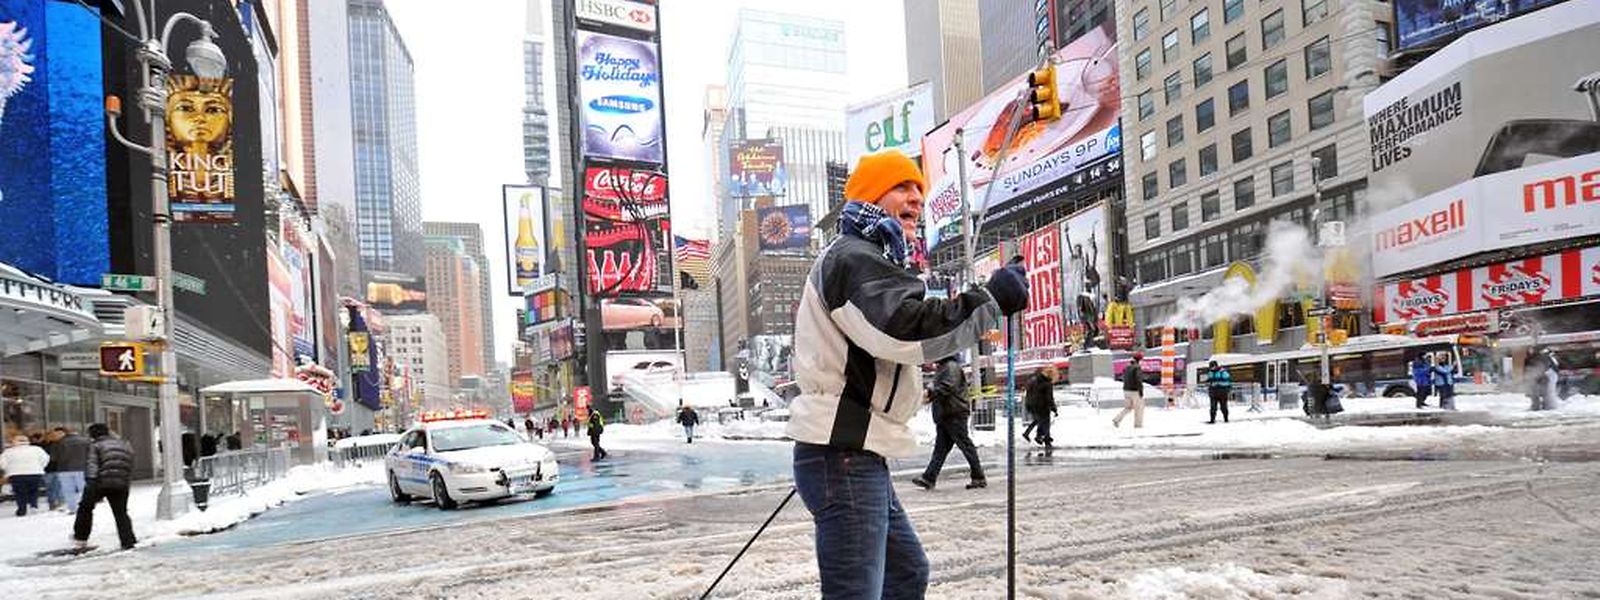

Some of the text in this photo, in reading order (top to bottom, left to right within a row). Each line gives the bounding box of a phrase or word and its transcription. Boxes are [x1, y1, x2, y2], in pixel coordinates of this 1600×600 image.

[579, 0, 626, 19] HSBC
[596, 52, 640, 69] Happy
[581, 65, 657, 87] Holidays
[594, 98, 648, 112] SAMSUNG
[1368, 96, 1409, 126] WHERE
[1370, 82, 1462, 144] MAXIMUM
[865, 100, 915, 152] elf
[1371, 102, 1462, 156] PERFORMANCE
[169, 152, 230, 171] KING
[1004, 138, 1098, 188] SUNDAYS 9P
[1372, 146, 1412, 172] LIVES
[170, 170, 233, 193] TUT
[1375, 199, 1465, 251] maxell
[1025, 267, 1061, 314] IDE
